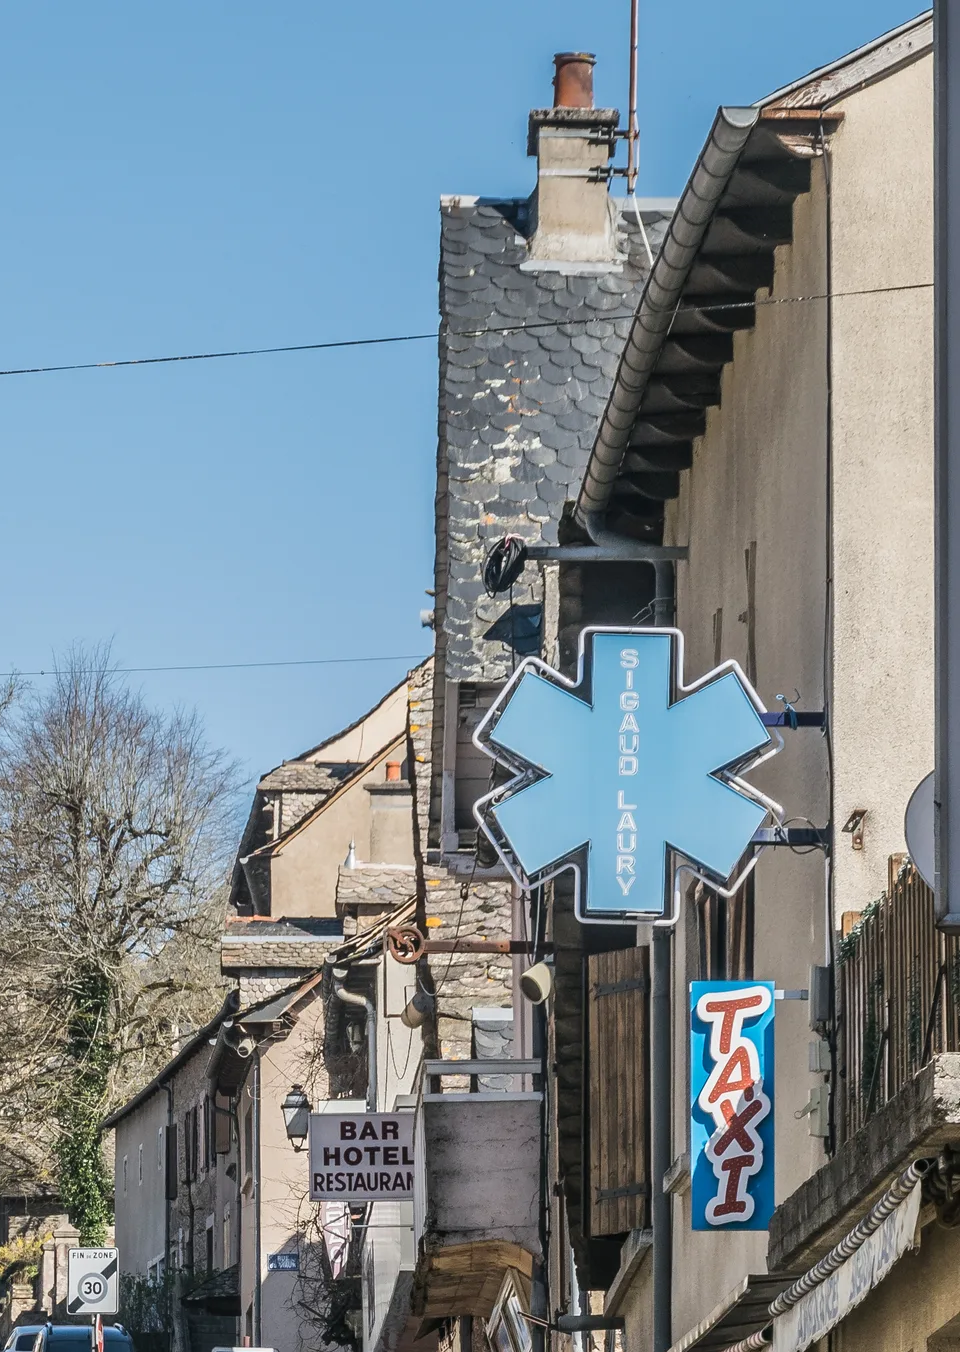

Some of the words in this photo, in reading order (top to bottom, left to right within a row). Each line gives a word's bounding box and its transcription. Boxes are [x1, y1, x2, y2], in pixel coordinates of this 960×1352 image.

[619, 648, 640, 776] SIGAUD
[616, 790, 637, 896] LAURY
[340, 1121, 399, 1140] BAR
[705, 994, 763, 1217] TAXI
[323, 1146, 414, 1166] HOTEL
[84, 1282, 102, 1295] 30
